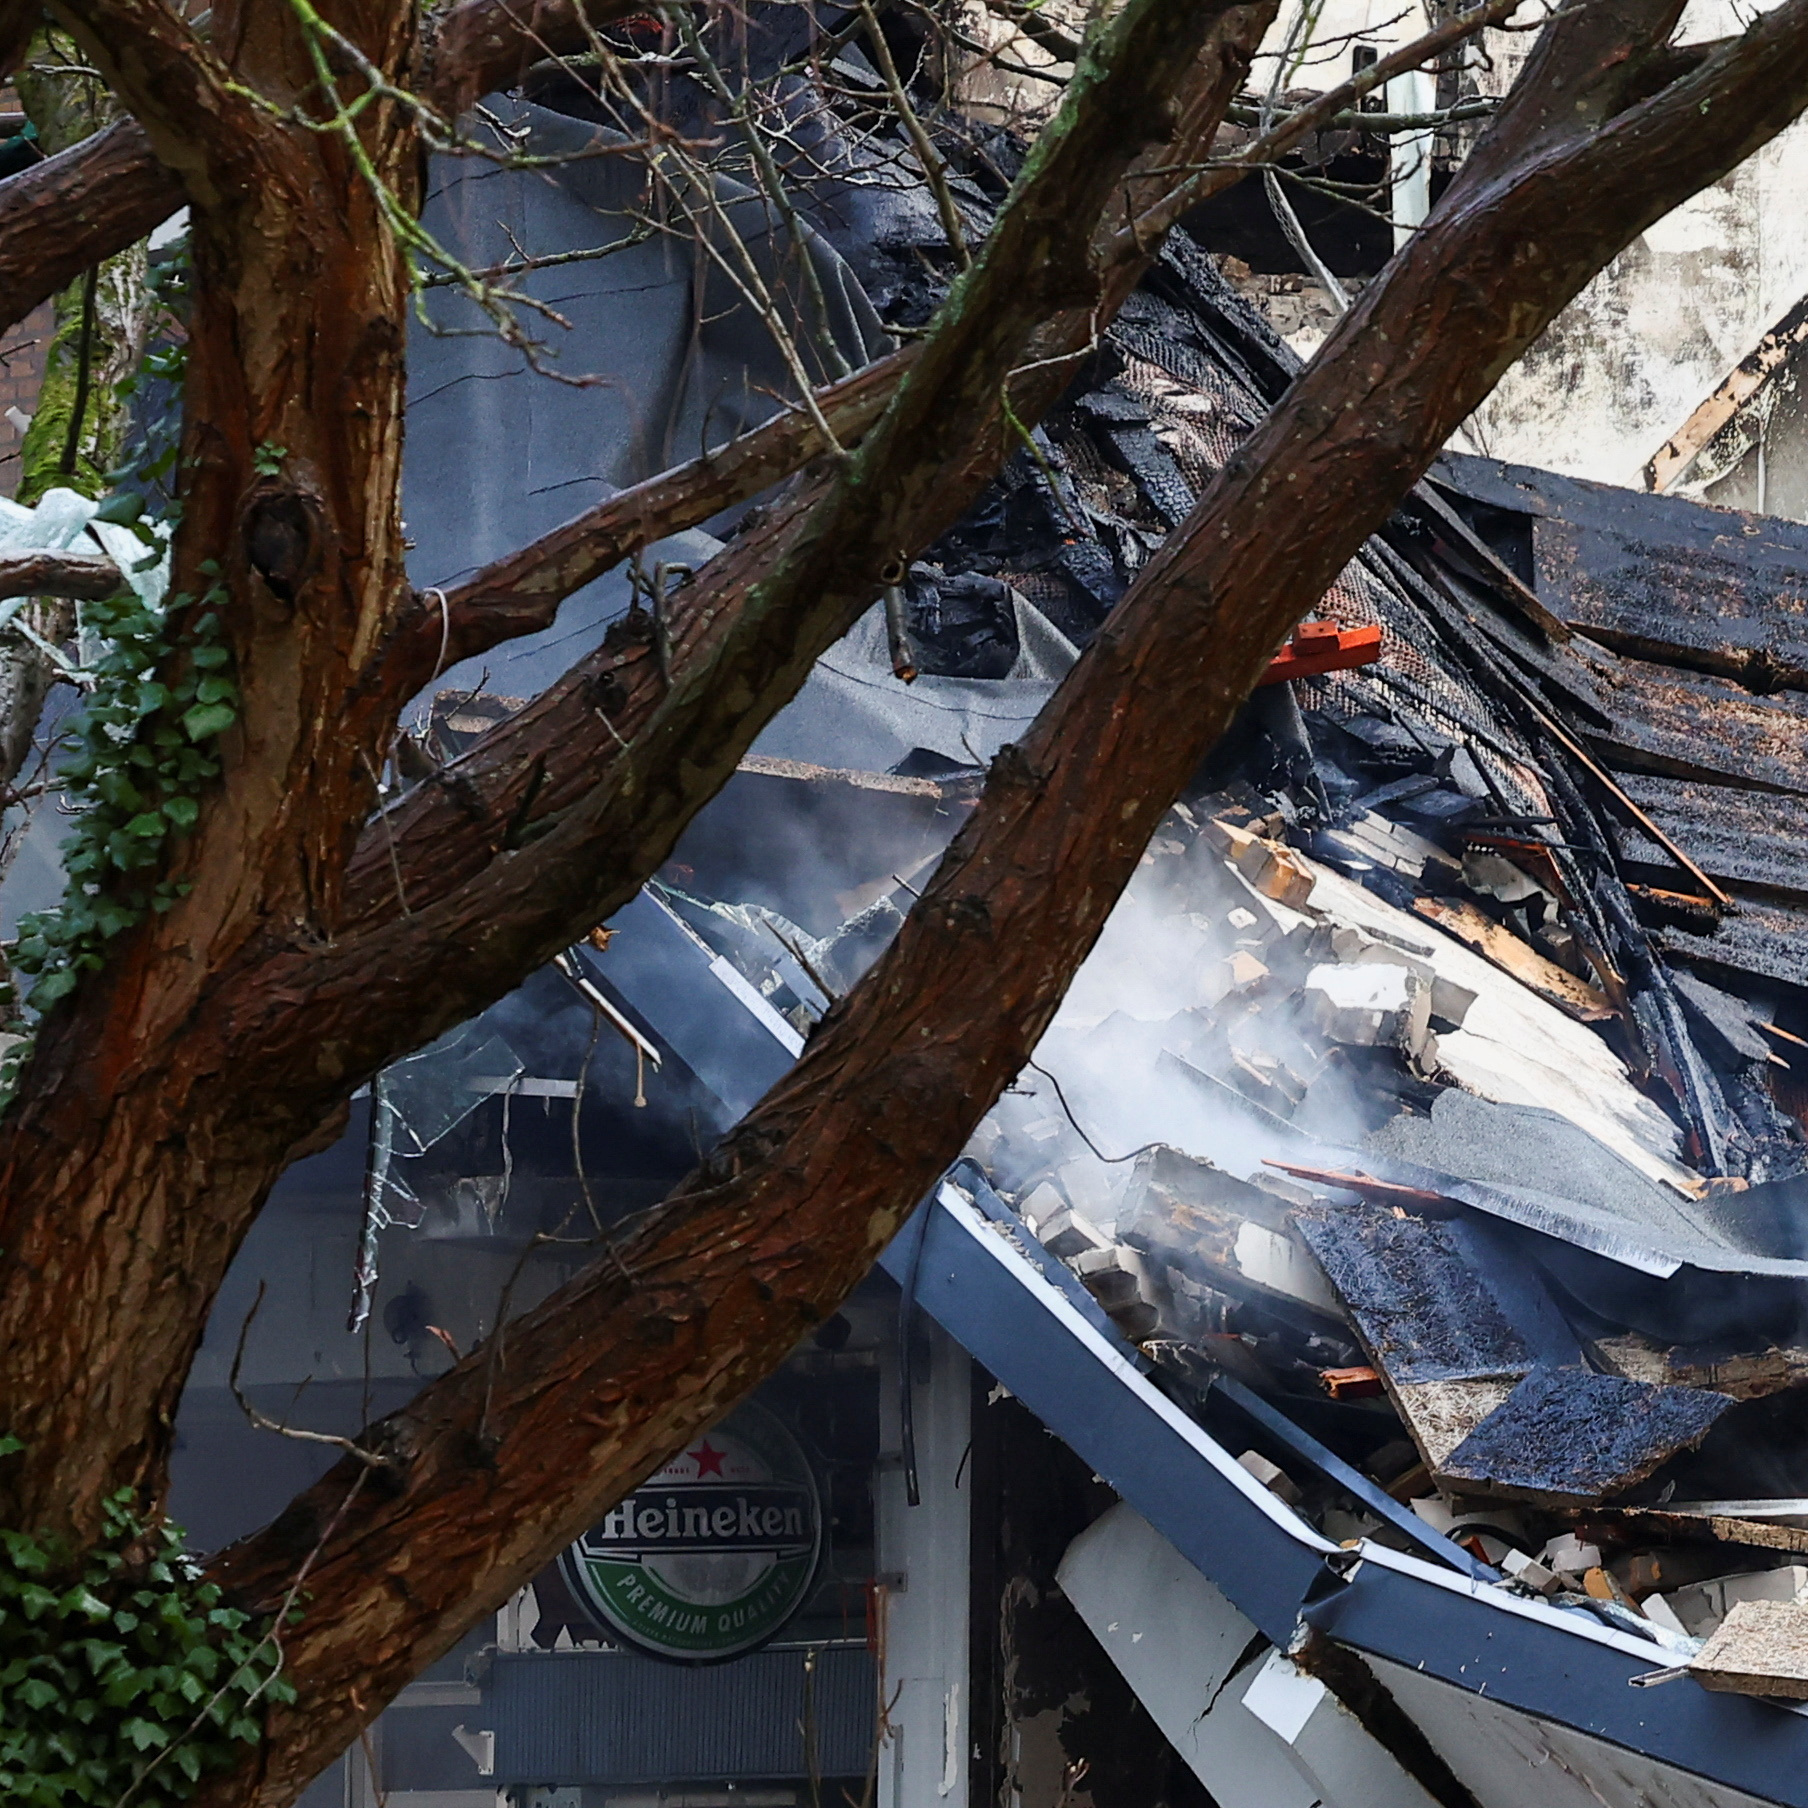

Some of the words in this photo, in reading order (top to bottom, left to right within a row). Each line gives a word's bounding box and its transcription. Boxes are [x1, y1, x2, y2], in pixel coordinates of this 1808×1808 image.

[601, 1498, 804, 1540] Heineken
[616, 1573, 708, 1635] PREMIUM
[718, 1571, 791, 1633] QUALITY
